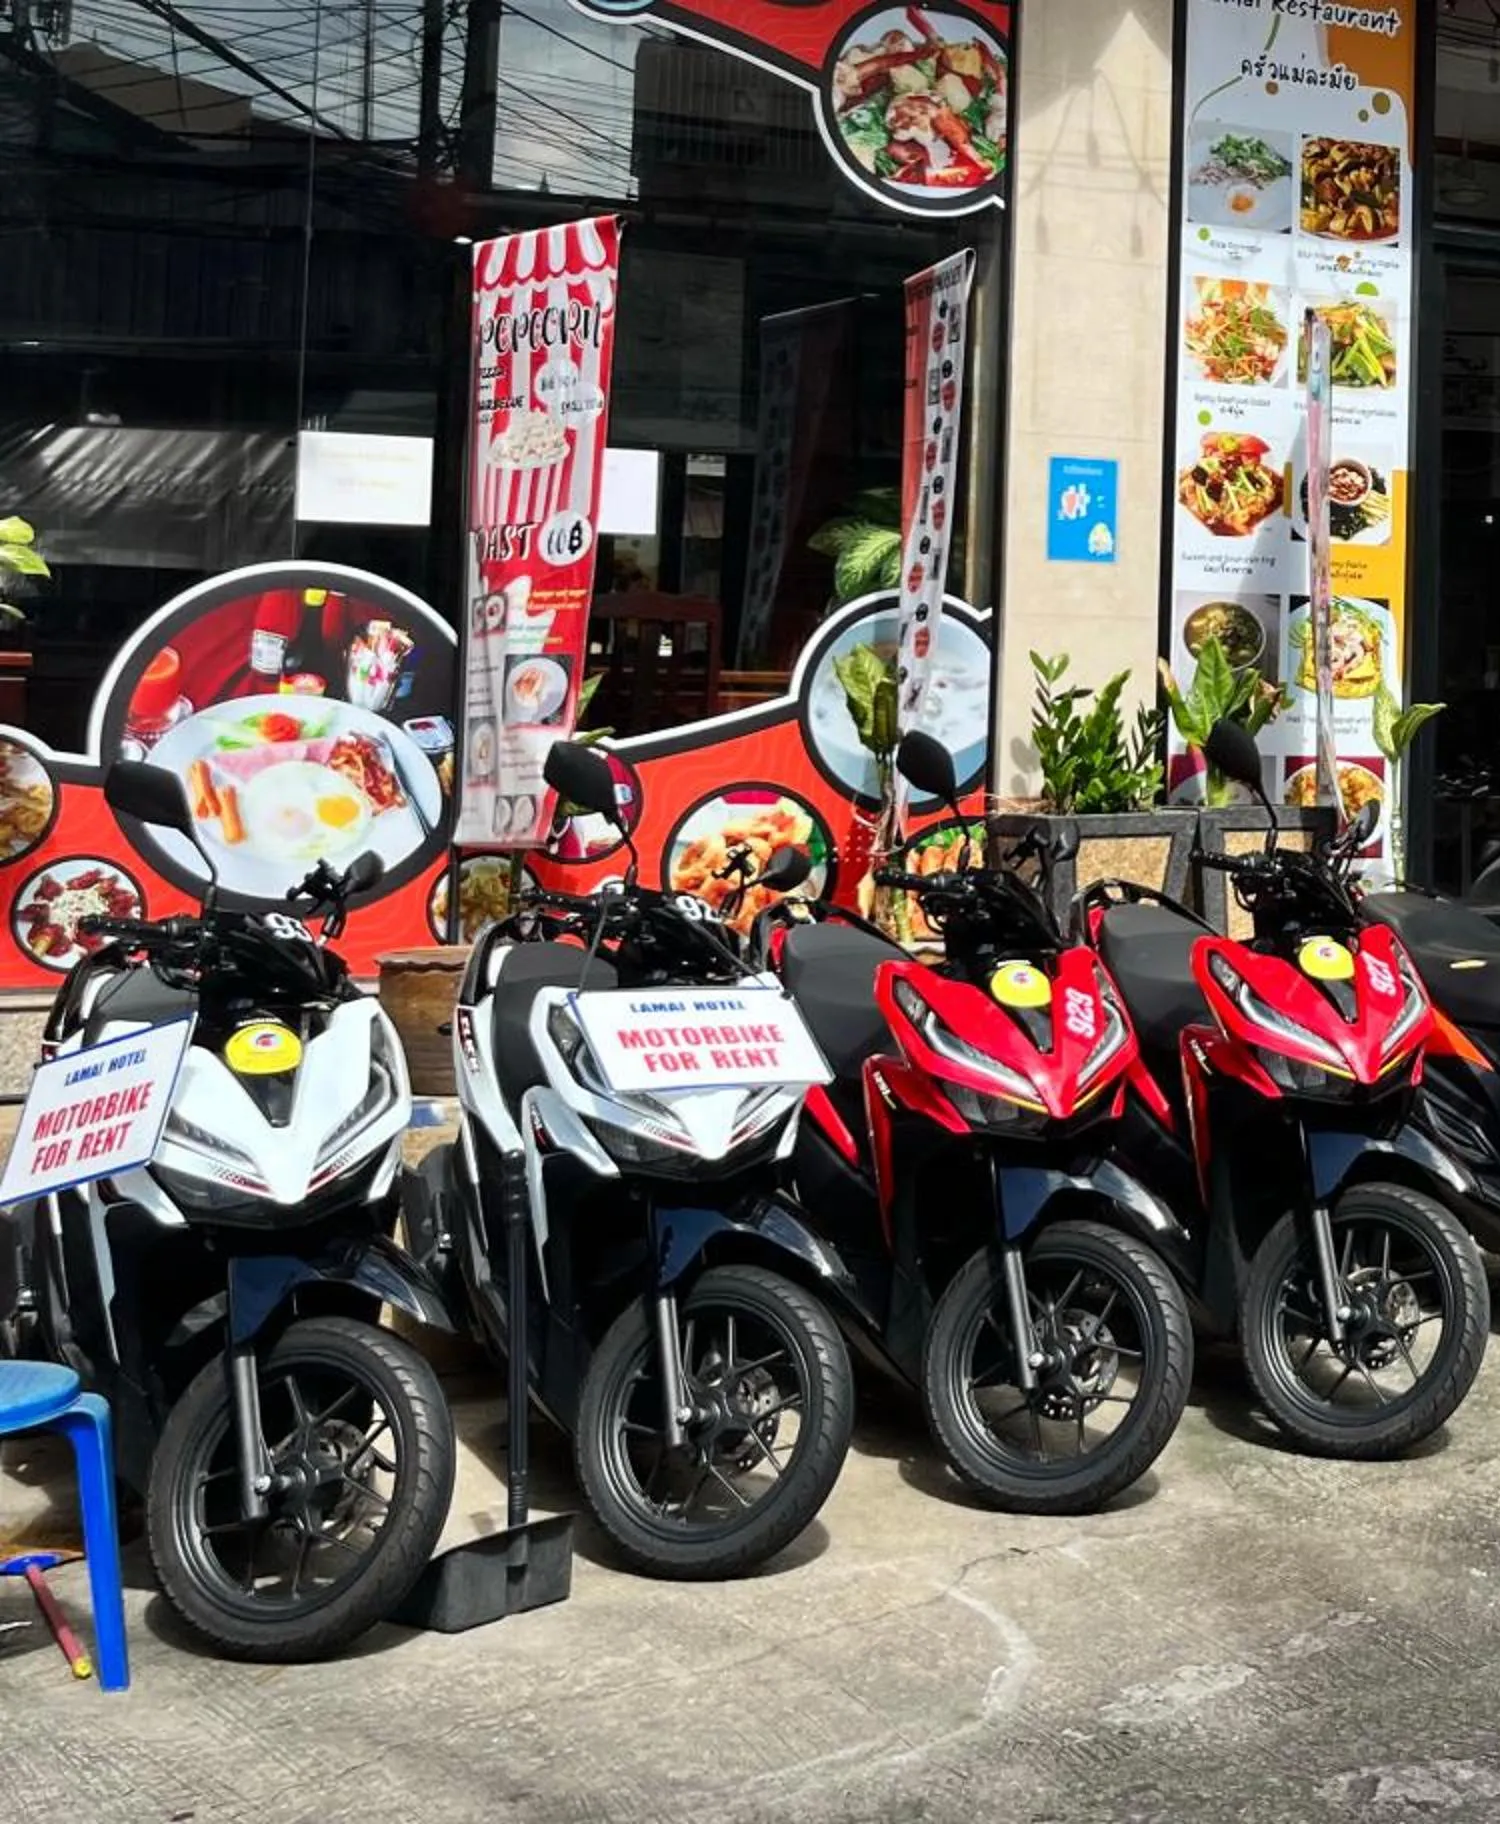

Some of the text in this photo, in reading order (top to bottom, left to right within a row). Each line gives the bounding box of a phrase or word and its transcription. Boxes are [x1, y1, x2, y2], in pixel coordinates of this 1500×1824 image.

[1271, 0, 1399, 32] Restaurant
[480, 302, 600, 356] POPCORN
[629, 999, 747, 1013] LAMAI HOTEL
[616, 1023, 784, 1049] MOTORBIKE
[64, 1048, 147, 1087] LAMAI HOTEL
[643, 1047, 781, 1073] FOR RENT
[32, 1080, 155, 1142] MOTORBIKE
[31, 1120, 134, 1175] FOR RENT
